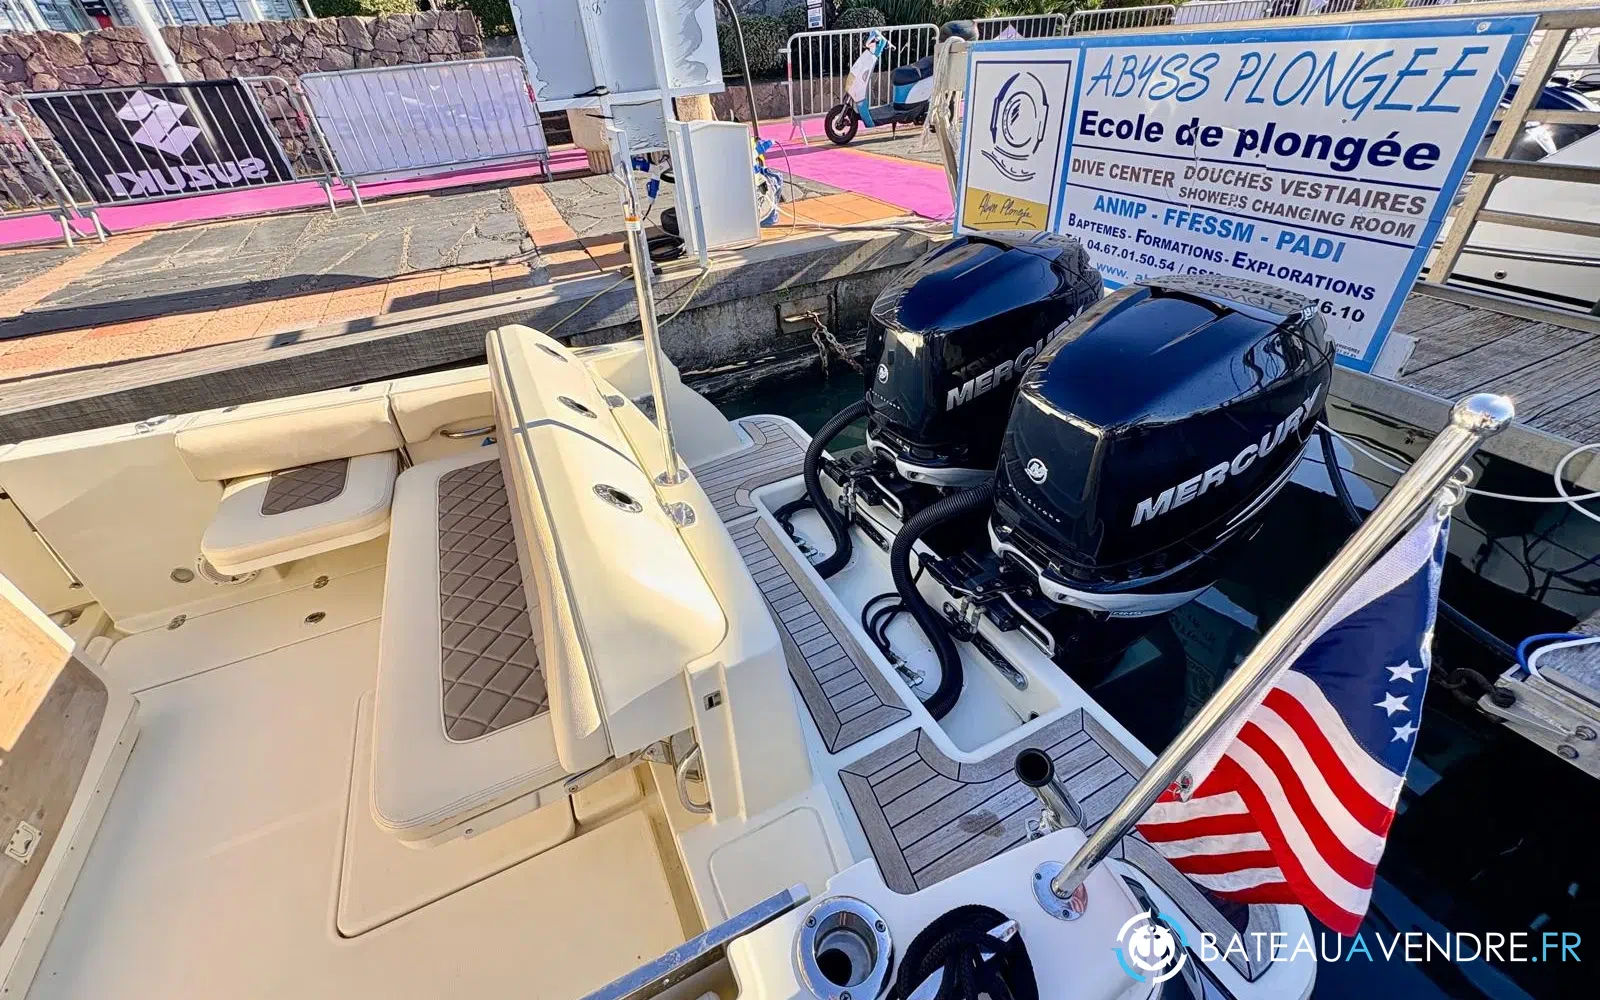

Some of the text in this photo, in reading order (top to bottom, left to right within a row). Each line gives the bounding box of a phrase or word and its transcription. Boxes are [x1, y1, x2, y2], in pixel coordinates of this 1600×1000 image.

[1086, 46, 1489, 121] ABYSS PLONGEE
[1079, 110, 1441, 172] Ecole de plongée
[1072, 158, 1176, 188] DIVE CENTER
[1183, 165, 1427, 215] DOUCHES VESTIAIRES
[1093, 195, 1147, 219] ANMP
[1163, 208, 1255, 243] FFESSM
[1275, 230, 1346, 263] PADI
[1178, 187, 1416, 238] SHOWERS CHANGING ROOM
[1087, 240, 1175, 272] 04.67.01.50.54
[1131, 383, 1321, 527] MERCURY
